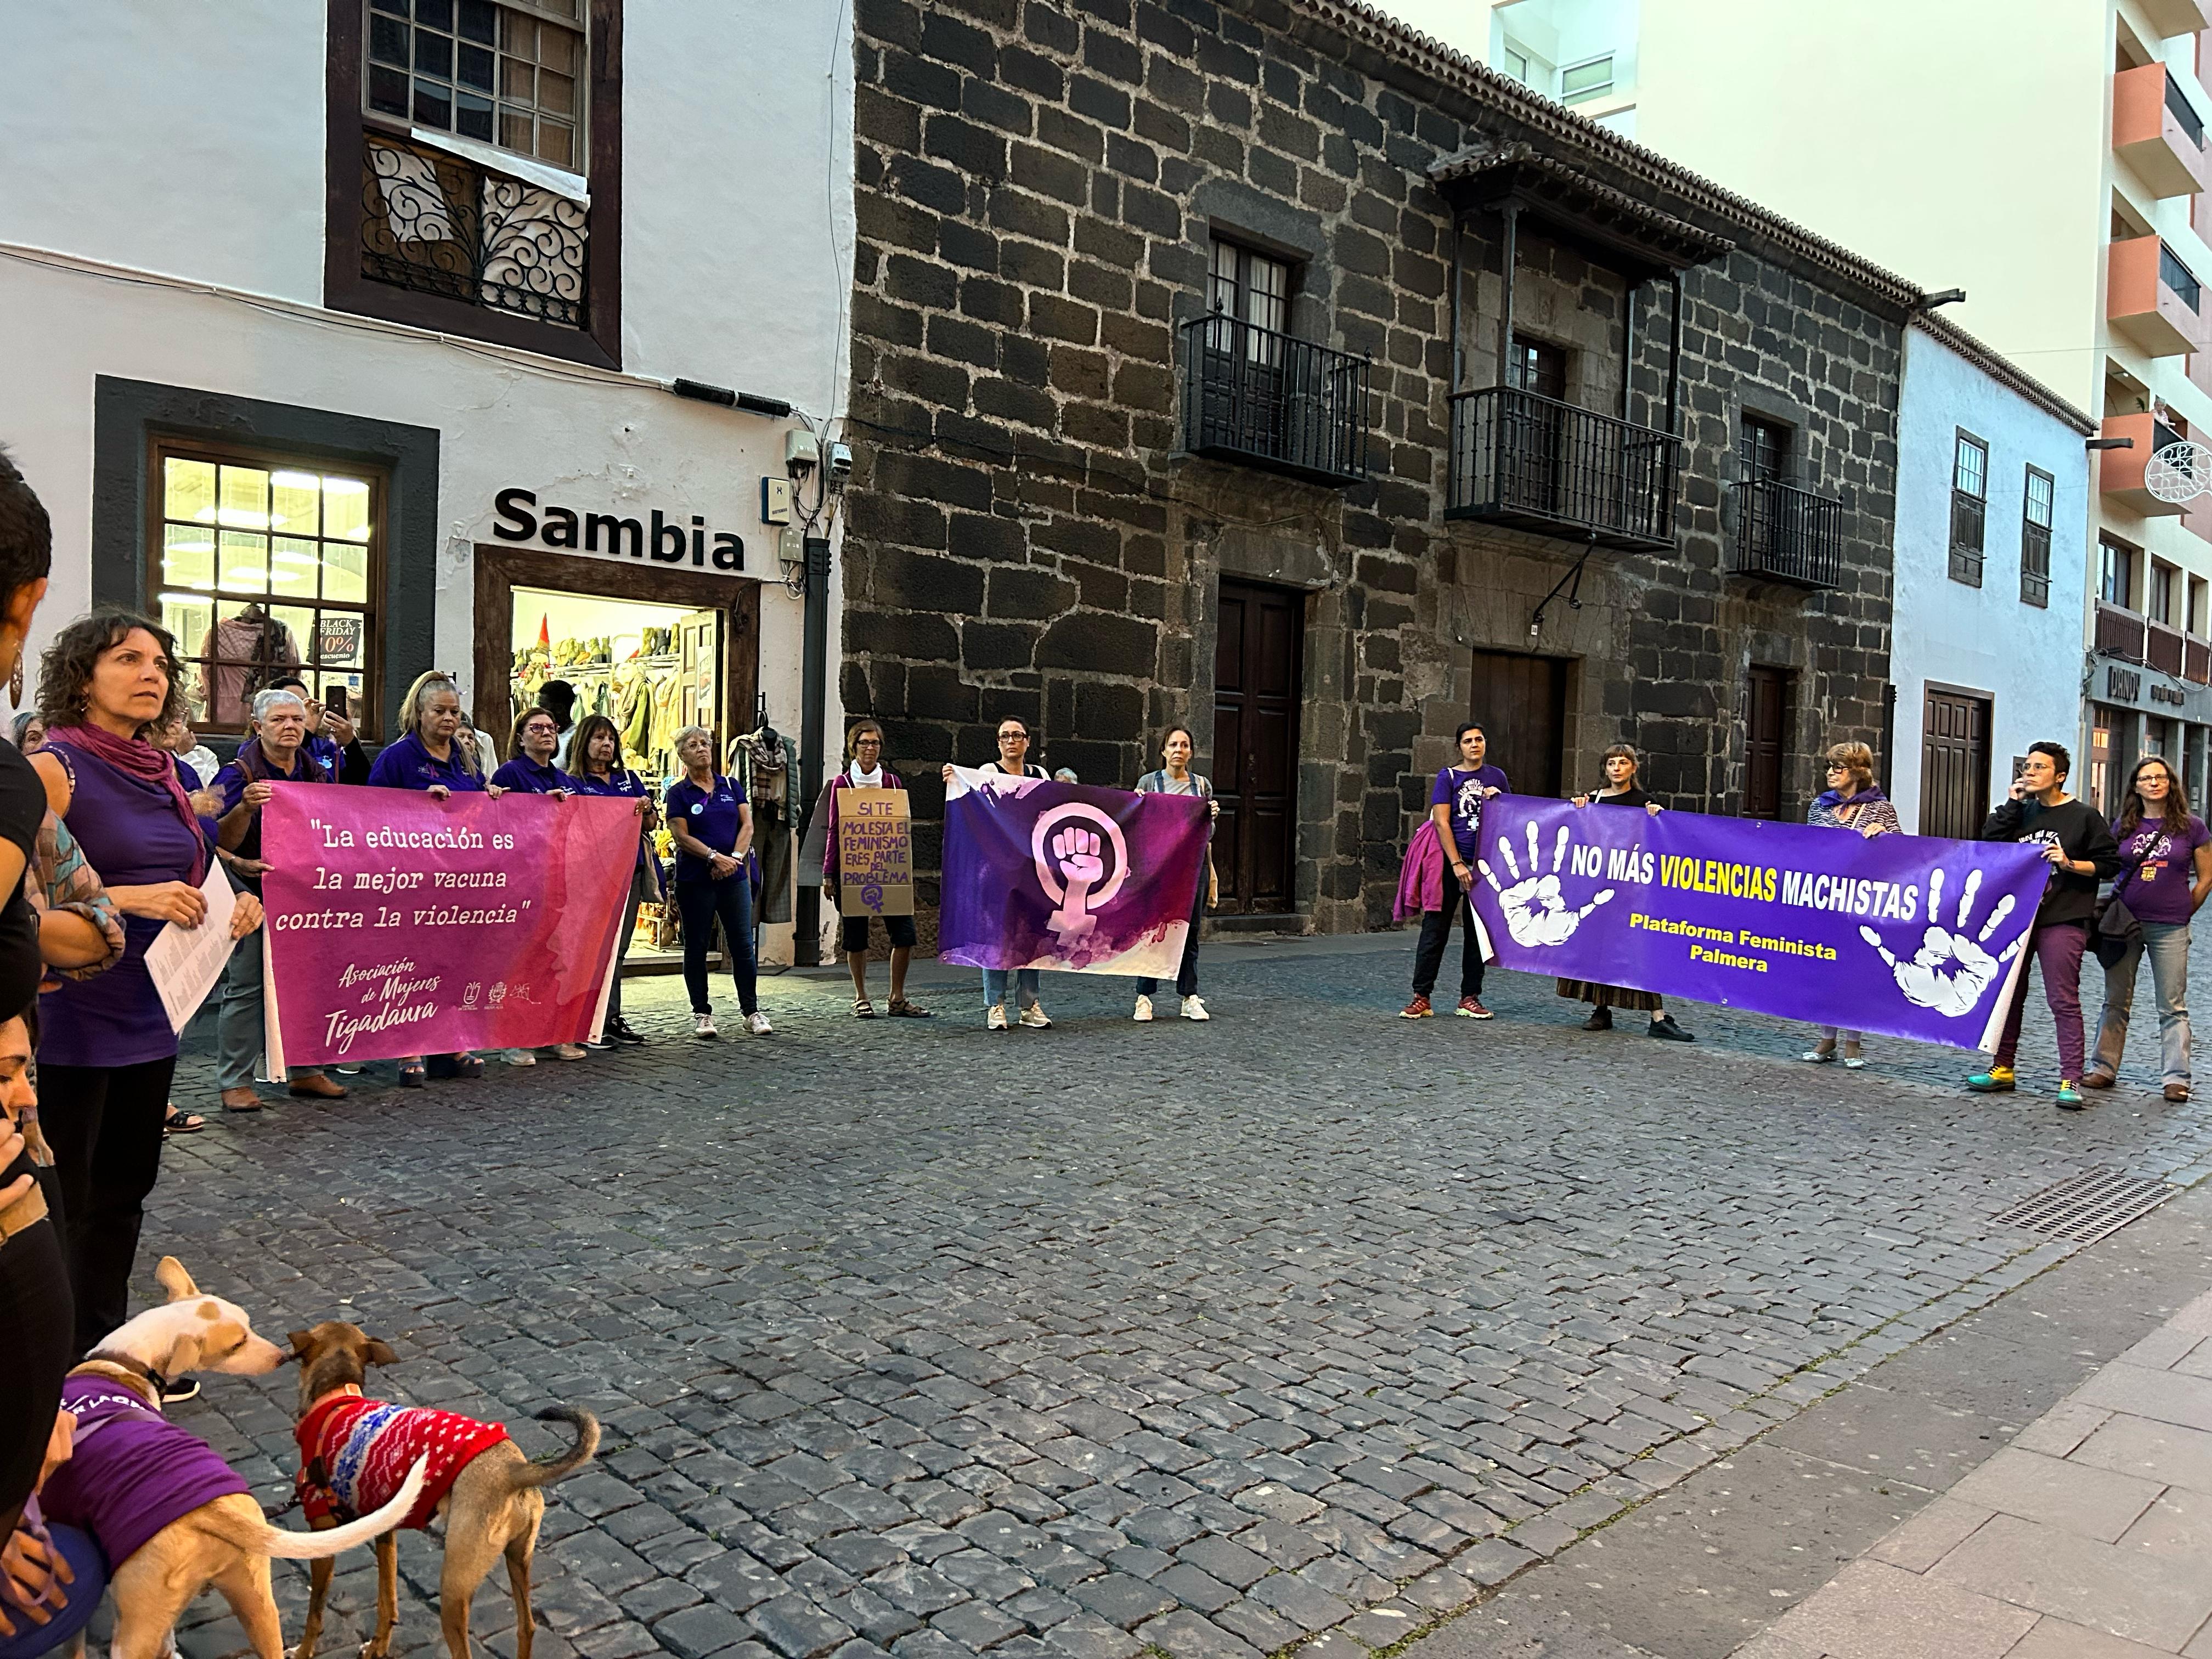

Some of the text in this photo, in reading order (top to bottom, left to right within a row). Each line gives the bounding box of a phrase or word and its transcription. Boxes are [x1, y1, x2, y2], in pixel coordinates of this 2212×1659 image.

[494, 488, 744, 571] Sambia
[320, 619, 353, 628] BLACK
[320, 627, 356, 635] FRIDAY
[2108, 665, 2141, 701] DANDY
[857, 802, 893, 816] SI TE
[311, 819, 514, 850] "La educación es
[843, 821, 911, 835] MOLESTA EL
[844, 836, 909, 851] FEMINISMO
[845, 850, 906, 867] ERES PARTE
[313, 867, 507, 894] la mejor vacuna
[844, 872, 909, 884] PROBLEMA
[1571, 843, 1919, 921] NO MÁS VIOLENCIAS MACHISTAS
[275, 900, 531, 931] contra la violencia"
[1629, 912, 1837, 961] Plataforma Feminista
[338, 956, 416, 988] Asociación
[1690, 944, 1768, 973] Palmera
[361, 975, 442, 1006] de Mujeres
[325, 1001, 439, 1055] Tigadaura
